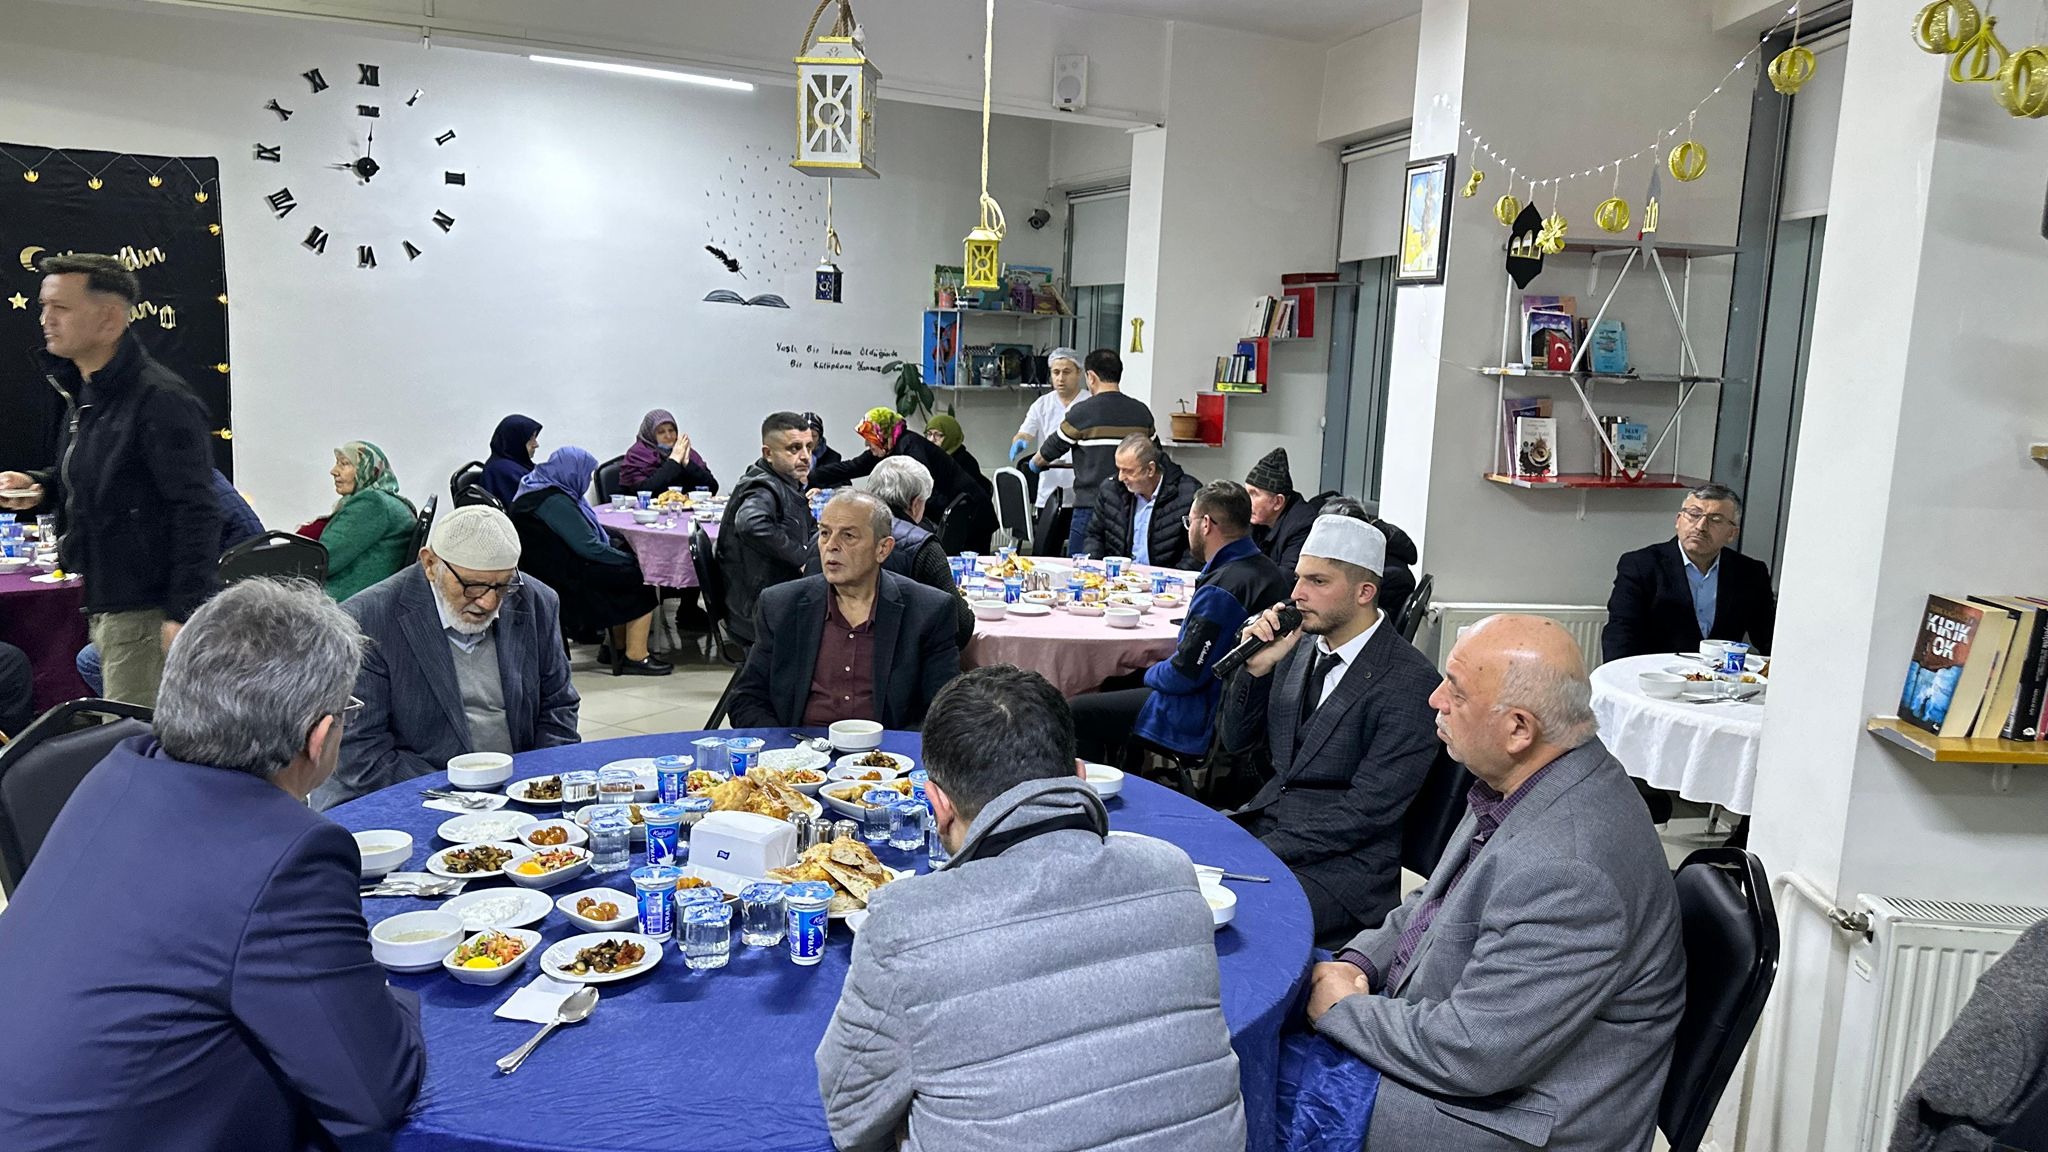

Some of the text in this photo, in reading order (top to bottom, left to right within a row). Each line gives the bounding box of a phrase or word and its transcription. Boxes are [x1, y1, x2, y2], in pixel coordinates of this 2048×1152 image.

[1926, 612, 1972, 645] KIRIK
[1932, 636, 1957, 660] OK
[807, 928, 815, 956] AYRAN
